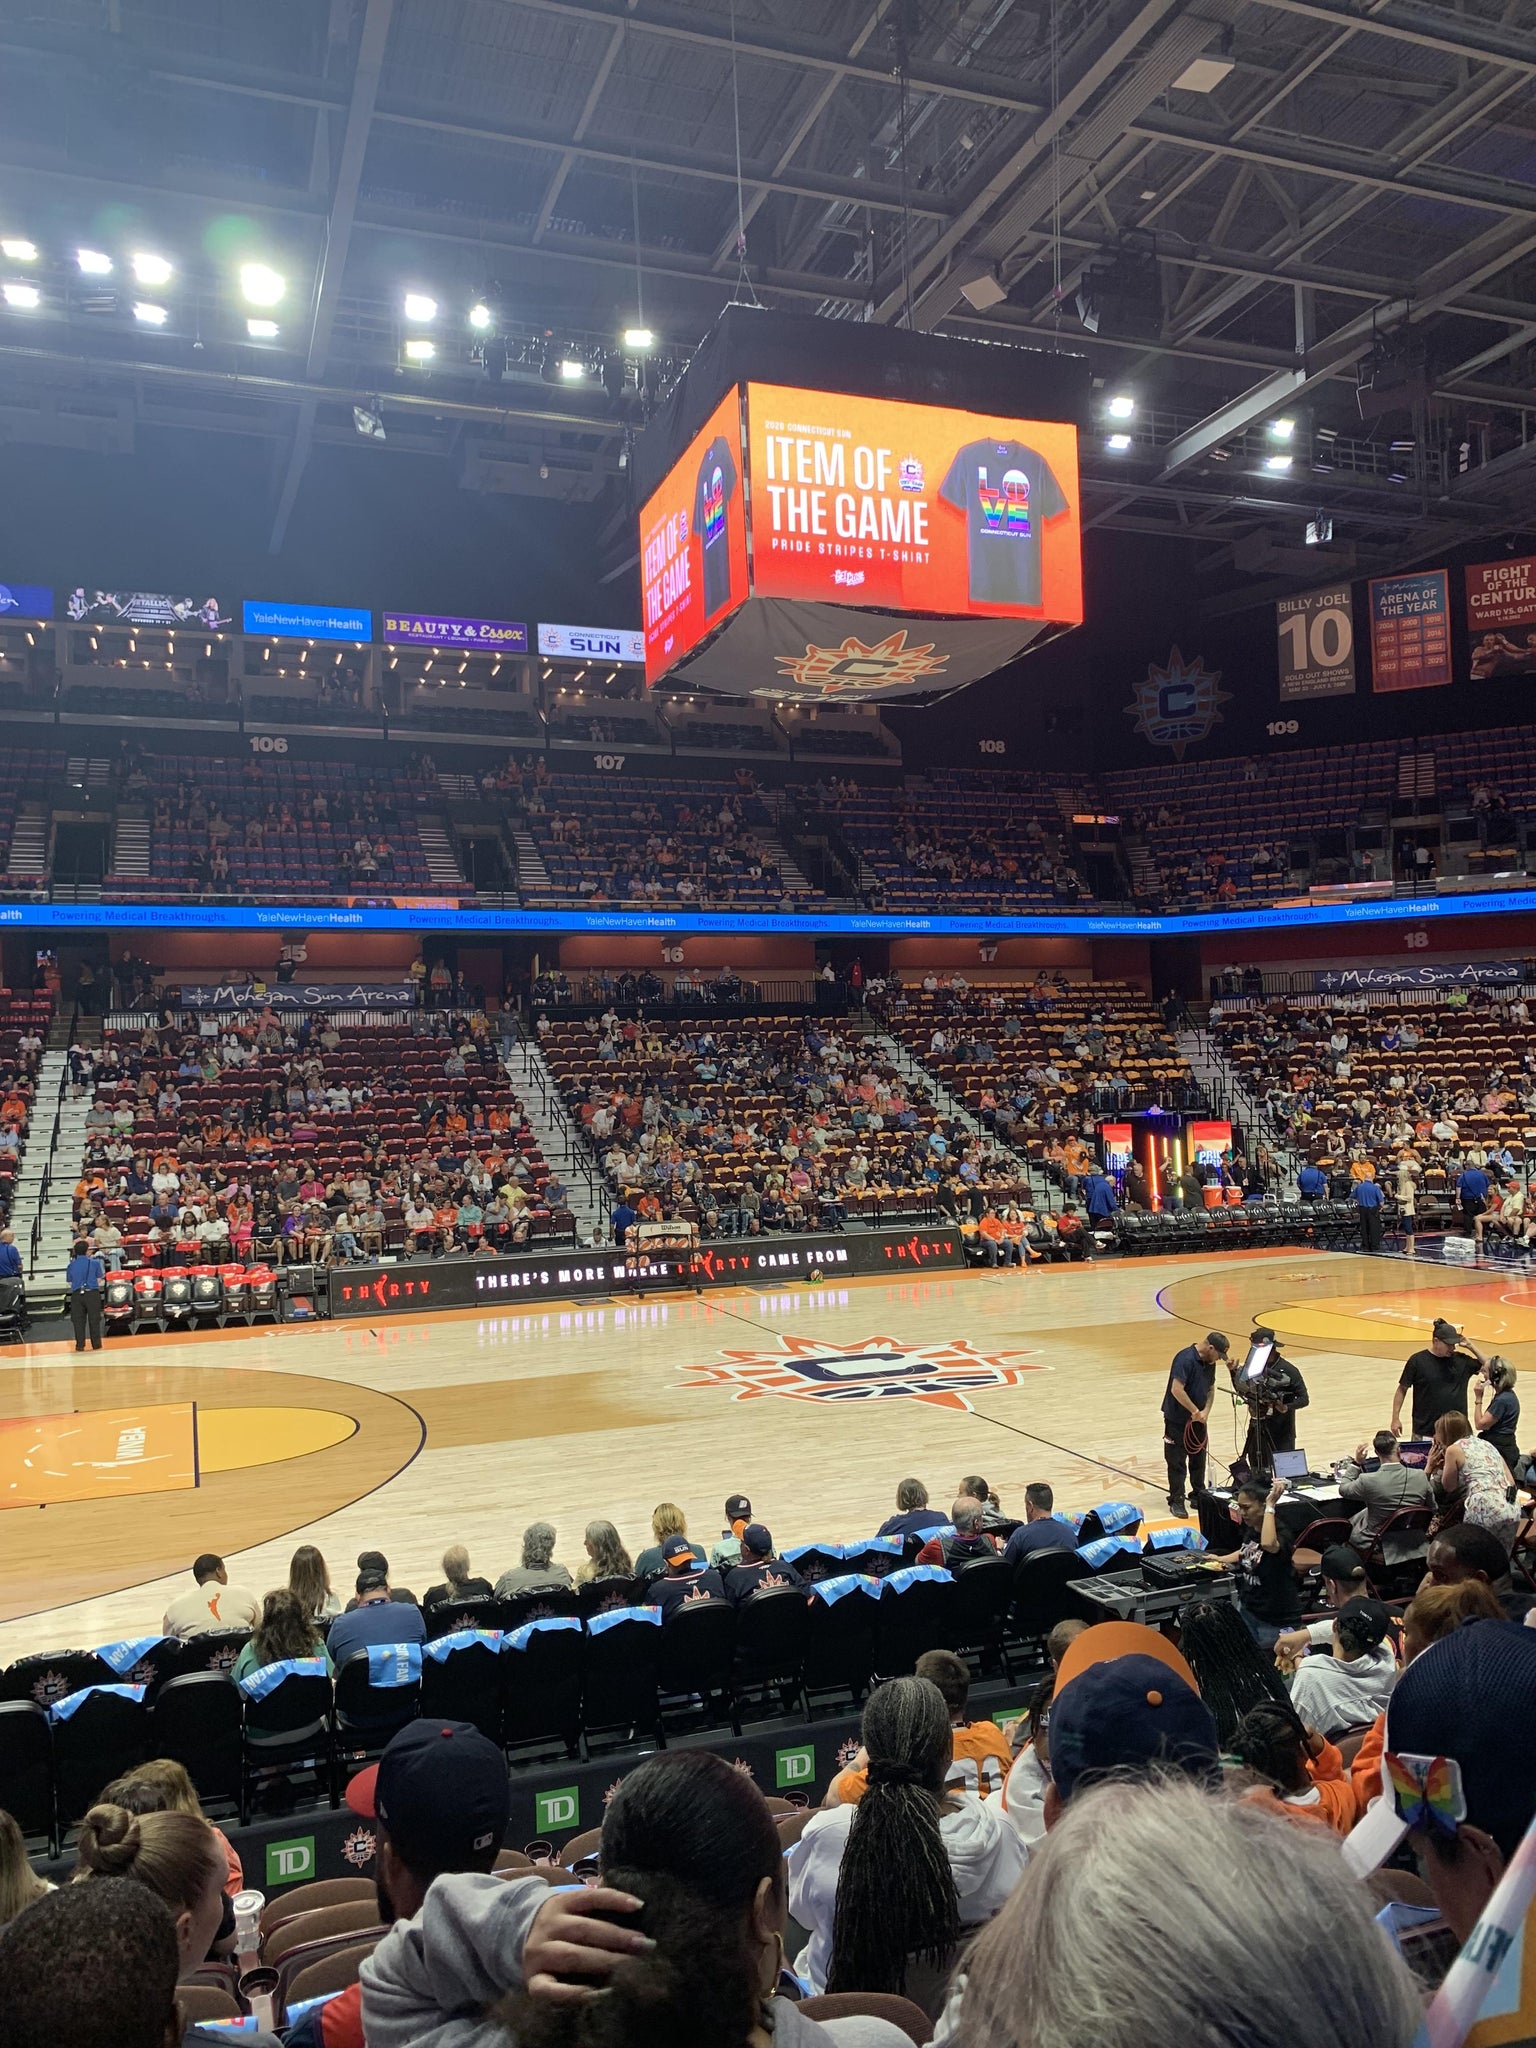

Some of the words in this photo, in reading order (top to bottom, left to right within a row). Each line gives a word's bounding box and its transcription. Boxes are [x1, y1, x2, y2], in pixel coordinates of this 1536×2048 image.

[787, 423, 835, 437] CONNECTICUT
[837, 428, 852, 439] SUN
[766, 435, 845, 488] ITEM
[854, 446, 892, 492] OF
[767, 485, 827, 535] THE
[835, 493, 929, 545] GAME
[644, 535, 666, 586] ITEM
[666, 512, 678, 555] OF
[772, 538, 811, 553] PRIDE
[818, 543, 873, 559] STRIPES
[880, 548, 930, 564] T-SHIRT
[1483, 564, 1531, 582] FIGHT
[646, 577, 663, 628] THE
[662, 546, 691, 611] GAME
[1487, 581, 1502, 591] OF
[1505, 577, 1528, 588] THE
[1279, 599, 1312, 612] BILLY
[1316, 593, 1350, 607] JOEL
[1380, 591, 1420, 606] ARENA
[1422, 588, 1438, 600] OF
[1470, 586, 1536, 607] CENTUR
[1381, 605, 1404, 617] THE
[1407, 600, 1437, 613] YEAR
[1475, 609, 1501, 619] WARD
[1503, 607, 1516, 616] VS.
[253, 612, 364, 631] YaleNewHavenHealth
[385, 619, 462, 637] BEAUTY
[464, 625, 479, 637] &
[480, 624, 523, 641] Essex
[568, 631, 621, 640] CONNECTICUT
[1279, 609, 1352, 670] 10
[569, 638, 621, 655] SUN
[1285, 674, 1304, 682] SOLD
[1305, 672, 1321, 680] OUT
[1322, 668, 1350, 678] SHOWS
[1266, 720, 1299, 735] 109
[250, 736, 288, 753] 106
[978, 740, 1006, 753] 108
[594, 755, 625, 770] 107
[1345, 903, 1439, 917] YaleNewHavenHealth
[1463, 899, 1505, 909] Powering
[51, 910, 101, 923] Powering
[105, 910, 147, 921] Medical
[151, 910, 228, 923] Breakthroughs.
[256, 912, 363, 923] YaleNewHavenHealth
[409, 914, 451, 926] Powering
[455, 915, 492, 925] Medical
[495, 915, 562, 927] Breakthroughs.
[586, 916, 676, 927] YaleNewHavenHealth
[698, 918, 735, 929] Powering
[737, 919, 769, 928] Medical
[771, 919, 830, 929] Breakthroughs.
[850, 919, 931, 929] YaleNewHavenHealth
[950, 920, 984, 930] Powering
[985, 920, 1014, 929] Medical
[1016, 920, 1068, 930] Breakthroughs.
[1182, 917, 1220, 928] Powering
[1222, 916, 1255, 926] Medical
[1258, 911, 1320, 923] Breakthroughs.
[1088, 921, 1162, 930] YaleNewHavenHealth
[1404, 932, 1429, 948] 18
[280, 945, 308, 962] 15
[661, 946, 684, 963] 16
[979, 947, 998, 962] 17
[1340, 968, 1416, 987] Mohegan
[1419, 967, 1455, 984] Sun
[1458, 964, 1519, 982] Arena
[213, 984, 300, 1007] Mohegan
[303, 986, 344, 1005] Sun
[347, 985, 410, 1005] Arena
[476, 1270, 549, 1289] THERE'S
[558, 1267, 604, 1283] MORE
[758, 1253, 800, 1267] CAME
[807, 1249, 848, 1263] FROM
[115, 1426, 147, 1461] WNBA
[108, 1645, 131, 1665] FAN
[394, 1643, 409, 1662] SUN
[244, 1670, 267, 1690] FAN
[396, 1662, 409, 1682] FAN
[779, 1753, 811, 1779] TD
[540, 1795, 575, 1824] TD
[271, 1846, 310, 1875] TD
